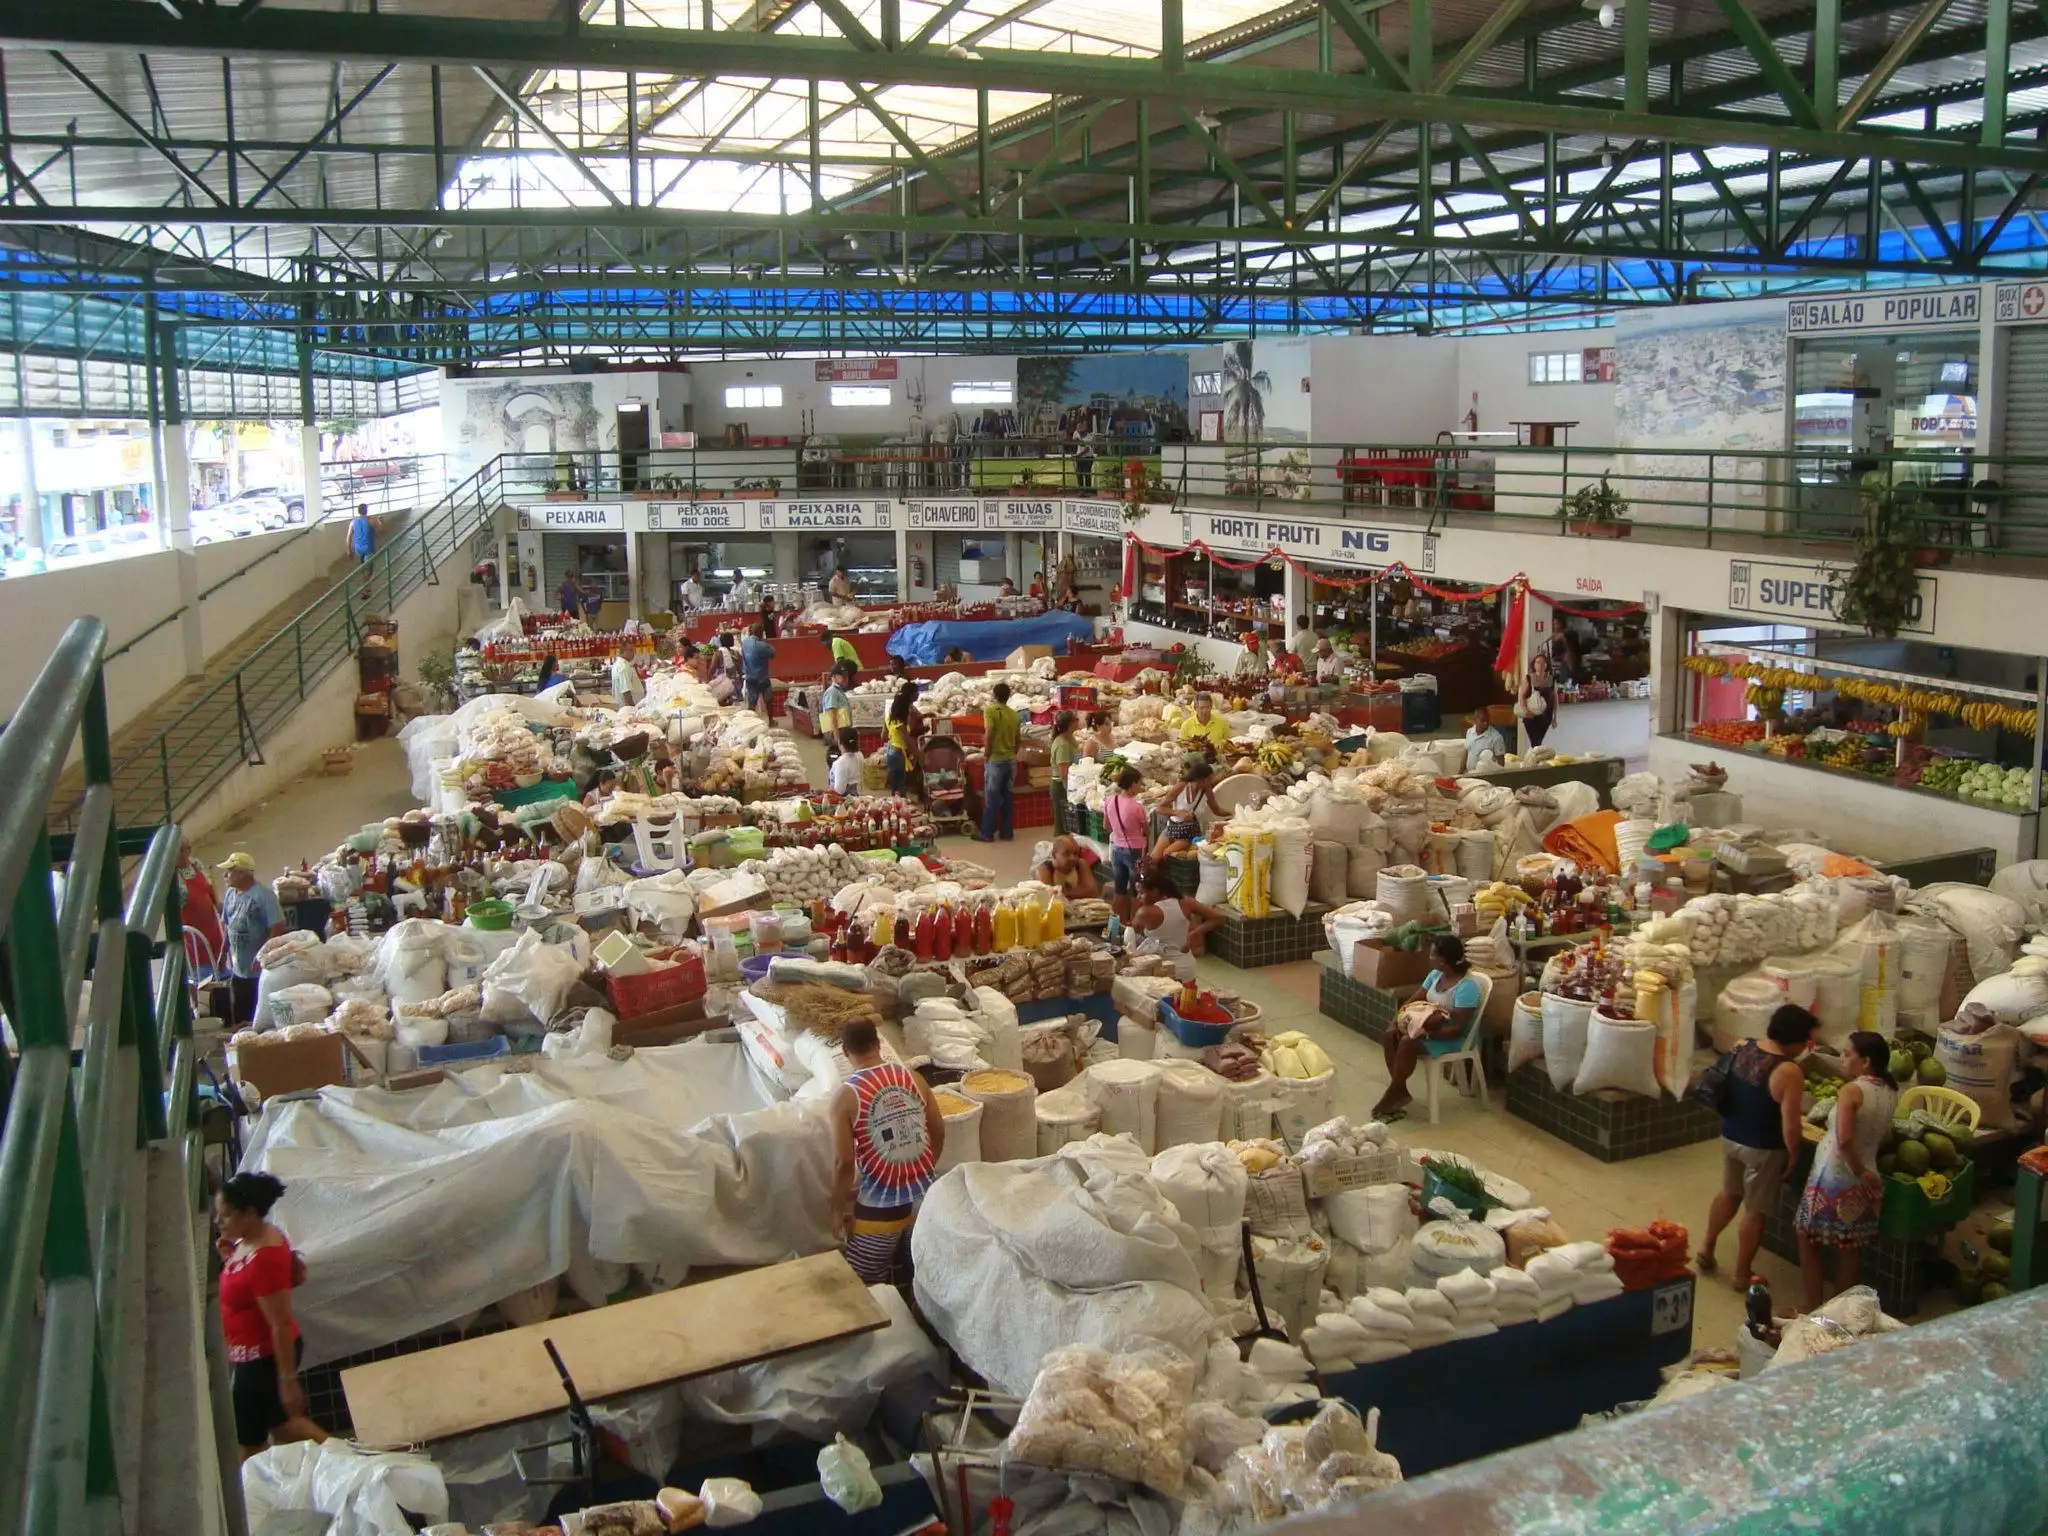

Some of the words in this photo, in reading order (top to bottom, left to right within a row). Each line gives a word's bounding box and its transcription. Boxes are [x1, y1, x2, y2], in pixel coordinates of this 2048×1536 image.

[1999, 287, 2017, 302] BOX
[1791, 303, 1805, 317] BOX
[1809, 300, 1864, 325] SALÃO
[1884, 294, 1976, 321] POPULAR
[2001, 303, 2013, 317] 05
[677, 507, 729, 516] PEIXARIA
[788, 503, 862, 514] PEIXARIA
[924, 505, 976, 522] CHAVEIRO
[1007, 503, 1053, 515] SILVAS
[546, 510, 607, 525] PEIXARIA
[681, 517, 698, 526] RIO
[703, 516, 730, 526] DOCE
[911, 515, 919, 525] 12
[988, 515, 995, 525] 11
[1211, 518, 1259, 538] HORTI
[1266, 523, 1320, 545] FRUTI
[1341, 530, 1389, 552] NG
[1732, 565, 1748, 583] BOX
[1733, 587, 1745, 605] 07
[1759, 578, 1835, 610] SUPER
